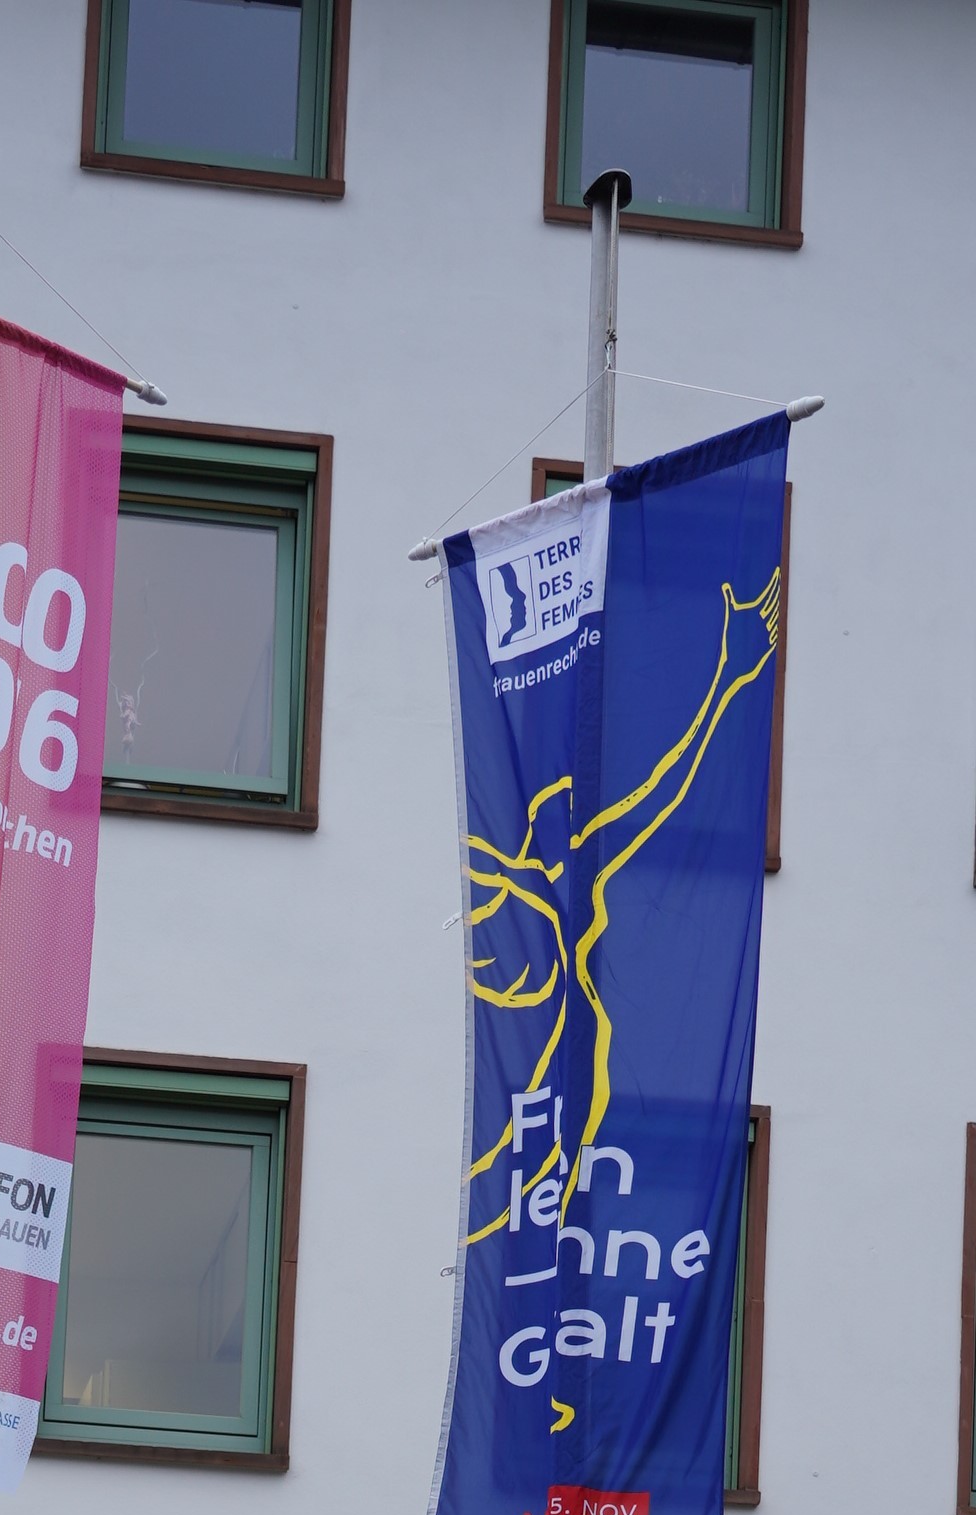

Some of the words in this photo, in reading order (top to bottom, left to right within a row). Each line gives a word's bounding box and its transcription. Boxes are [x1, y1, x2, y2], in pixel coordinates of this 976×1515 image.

[534, 532, 583, 570] TERR
[539, 571, 573, 600] DES
[493, 627, 601, 698] frauenrechde
[499, 1296, 676, 1388] Galt
[550, 1497, 570, 1515] 5.
